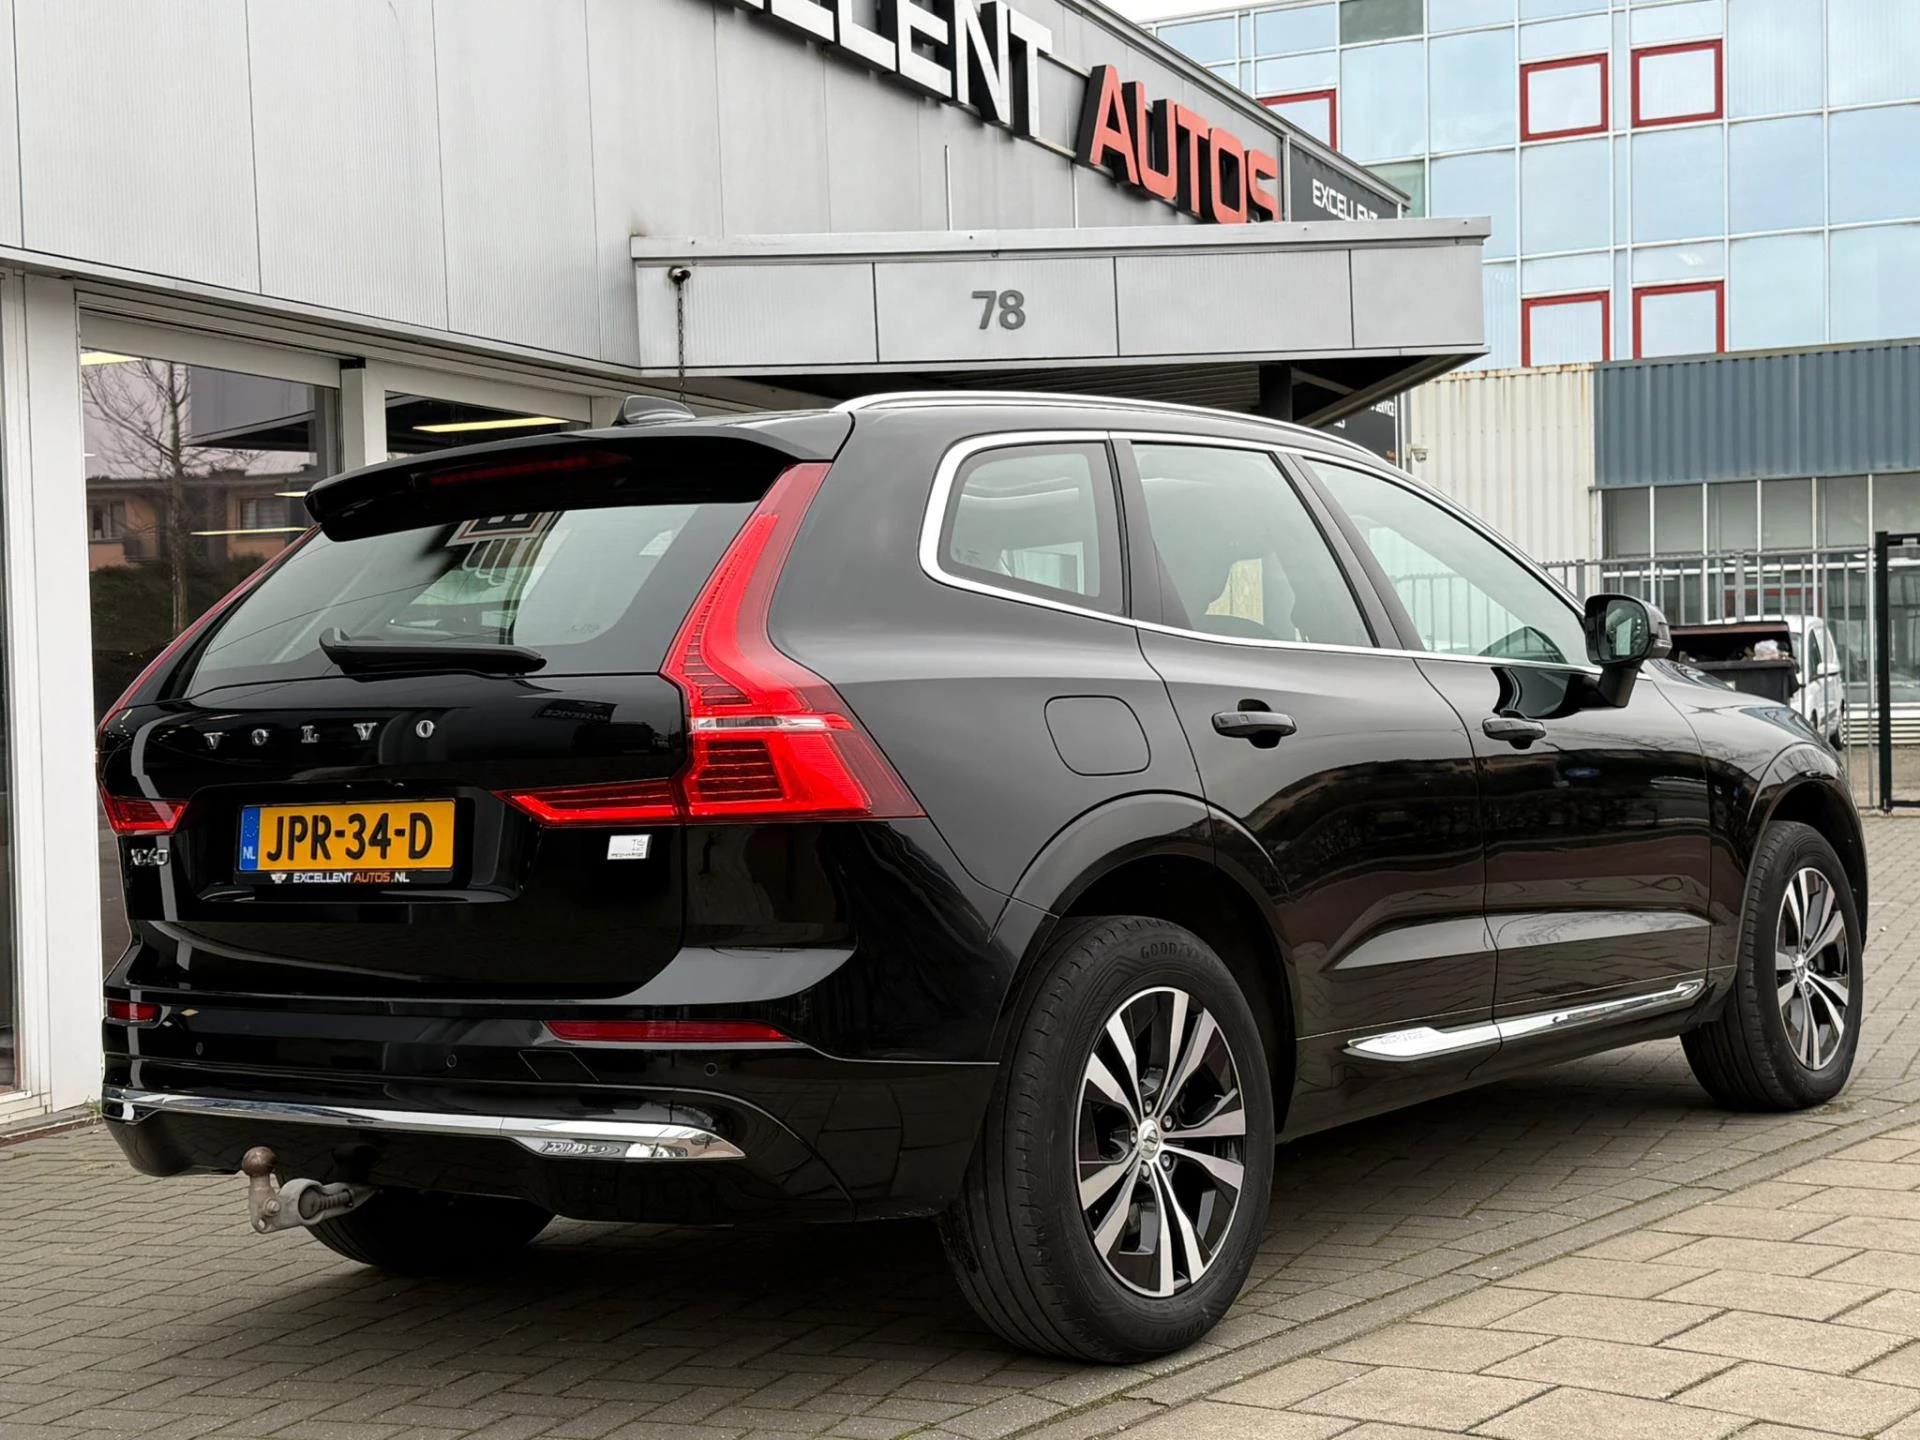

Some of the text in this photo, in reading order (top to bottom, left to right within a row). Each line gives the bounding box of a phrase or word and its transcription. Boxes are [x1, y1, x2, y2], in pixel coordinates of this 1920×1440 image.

[1088, 64, 1280, 224] AUTOS
[971, 289, 1026, 330] 78
[203, 719, 436, 750] VOLVO
[242, 846, 256, 860] NL
[266, 812, 433, 862] JPR-34-D
